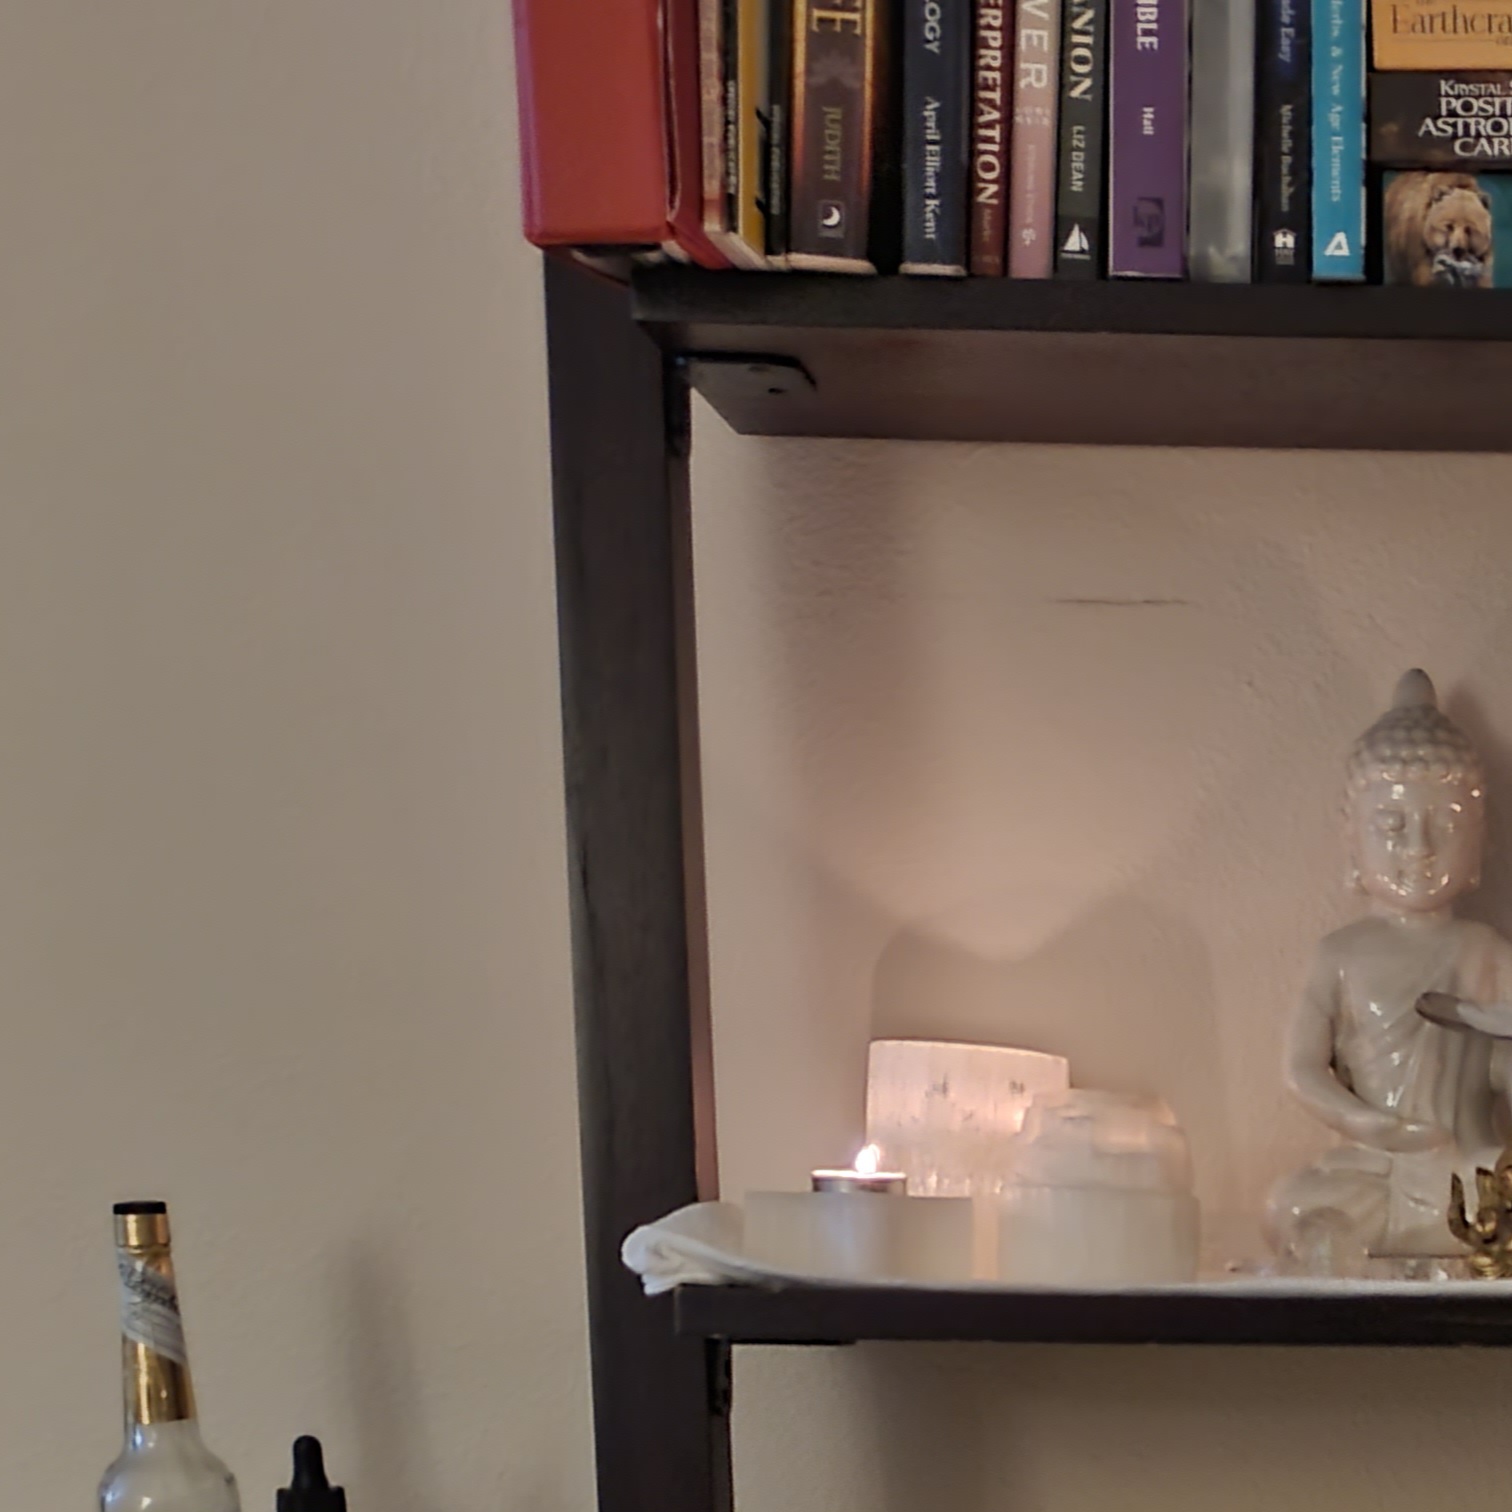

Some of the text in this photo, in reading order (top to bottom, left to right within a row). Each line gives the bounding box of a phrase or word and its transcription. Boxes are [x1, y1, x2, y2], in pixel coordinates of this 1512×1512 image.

[810, 0, 863, 37] E
[923, 0, 941, 55] OGY
[1018, 0, 1049, 90] VER
[1279, 26, 1295, 63] Easy
[1330, 64, 1344, 97] New
[922, 97, 941, 140] April
[1142, 106, 1155, 136] Hall
[1070, 125, 1086, 192] LIZ DEAN
[1329, 136, 1344, 202] Elements
[923, 198, 941, 240] Kent
